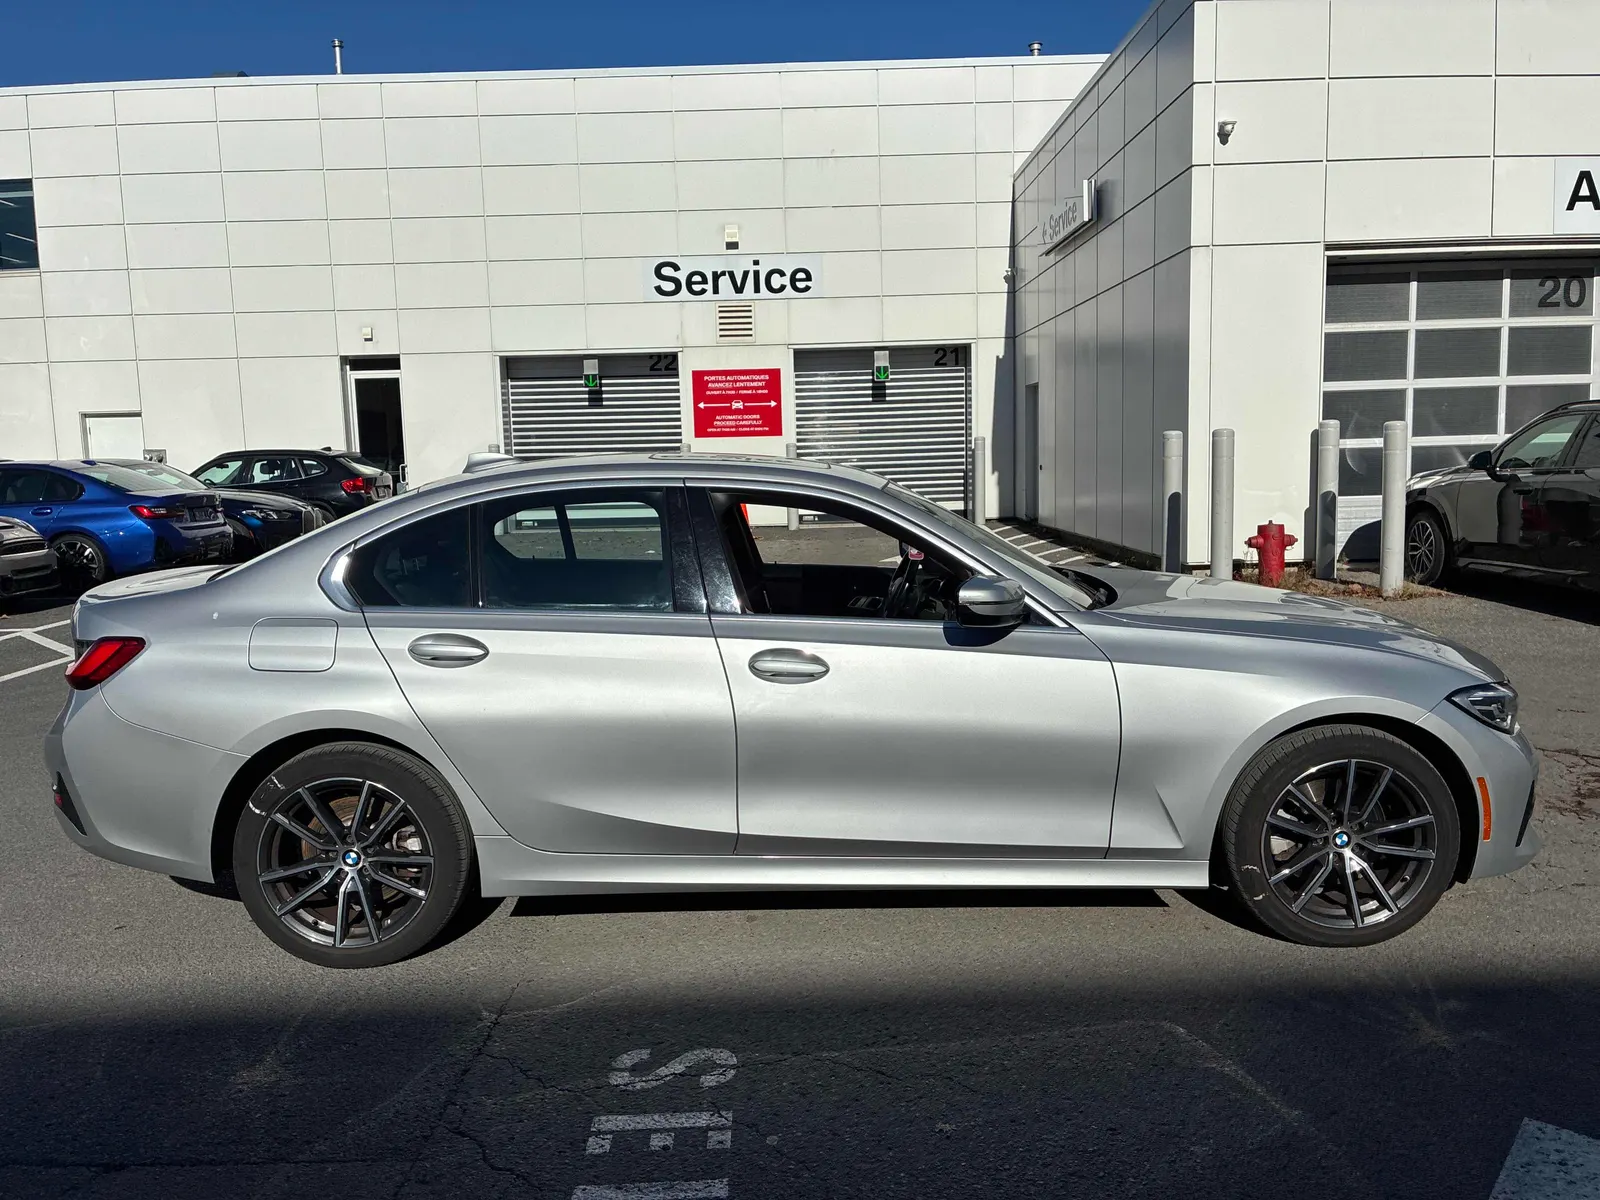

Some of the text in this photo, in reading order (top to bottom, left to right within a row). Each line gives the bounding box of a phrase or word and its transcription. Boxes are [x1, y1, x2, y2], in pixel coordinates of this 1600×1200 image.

[1049, 201, 1077, 241] Service
[653, 259, 813, 297] Service
[1537, 275, 1587, 308] 20
[648, 354, 678, 372] 22
[934, 347, 960, 367] 21
